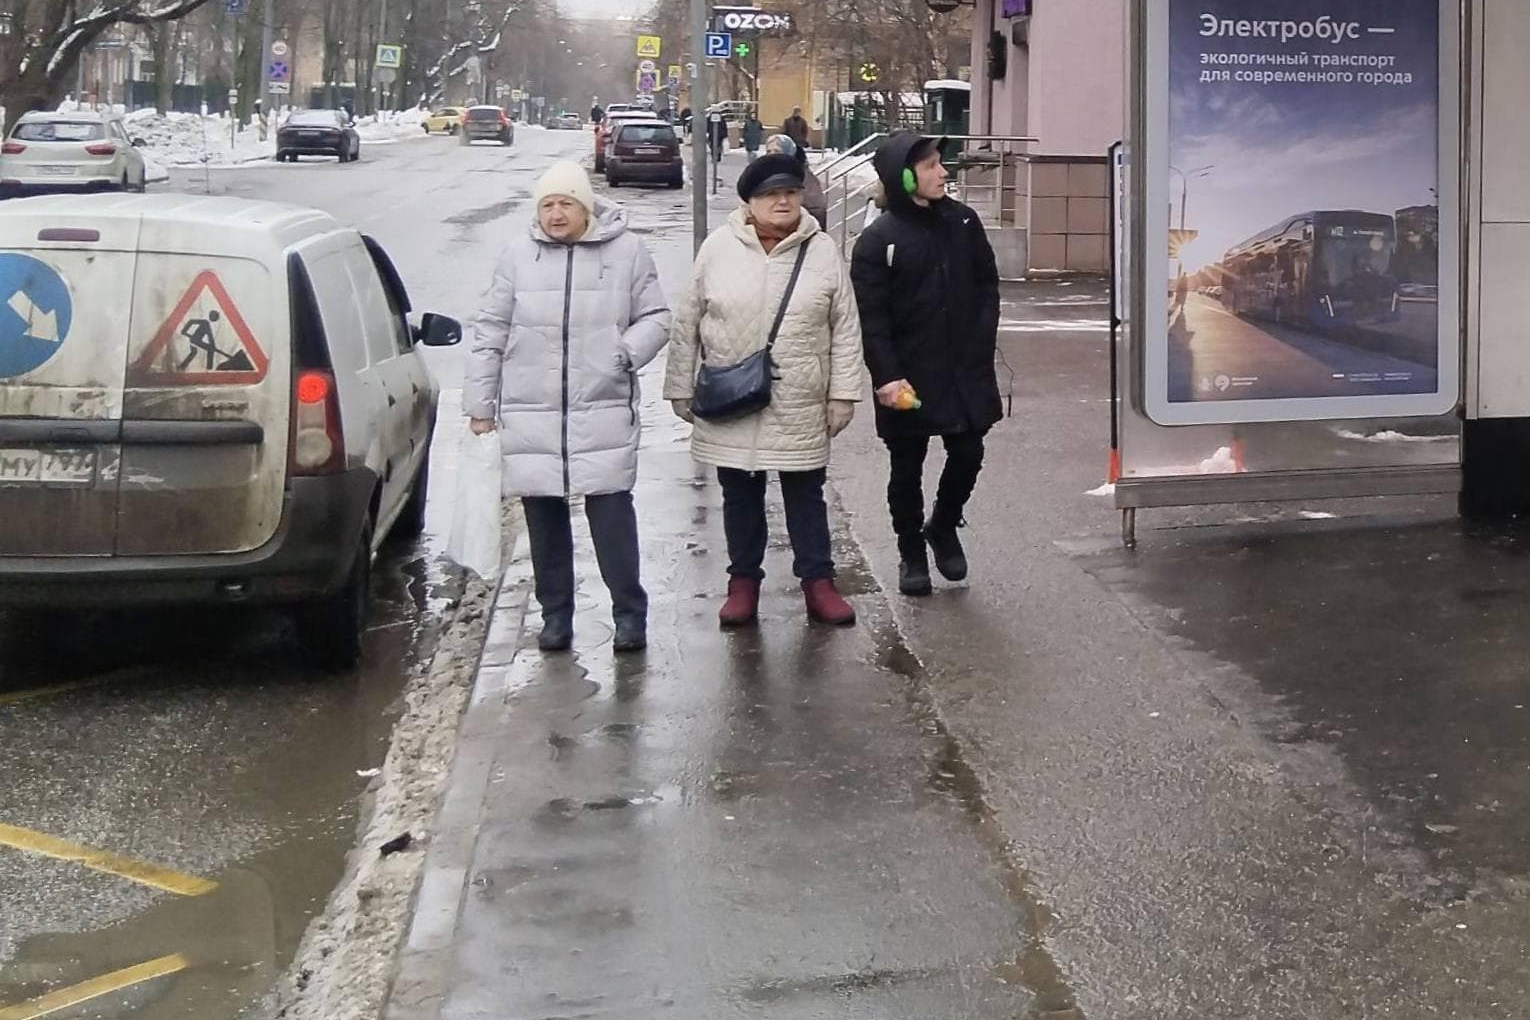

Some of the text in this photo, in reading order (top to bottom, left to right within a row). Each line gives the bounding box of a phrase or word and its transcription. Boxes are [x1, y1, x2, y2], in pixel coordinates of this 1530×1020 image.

[724, 12, 790, 29] OZON
[1199, 13, 1361, 43] Электробус
[1200, 51, 1396, 67] экологичный транспорт
[1199, 68, 1413, 85] для современного города
